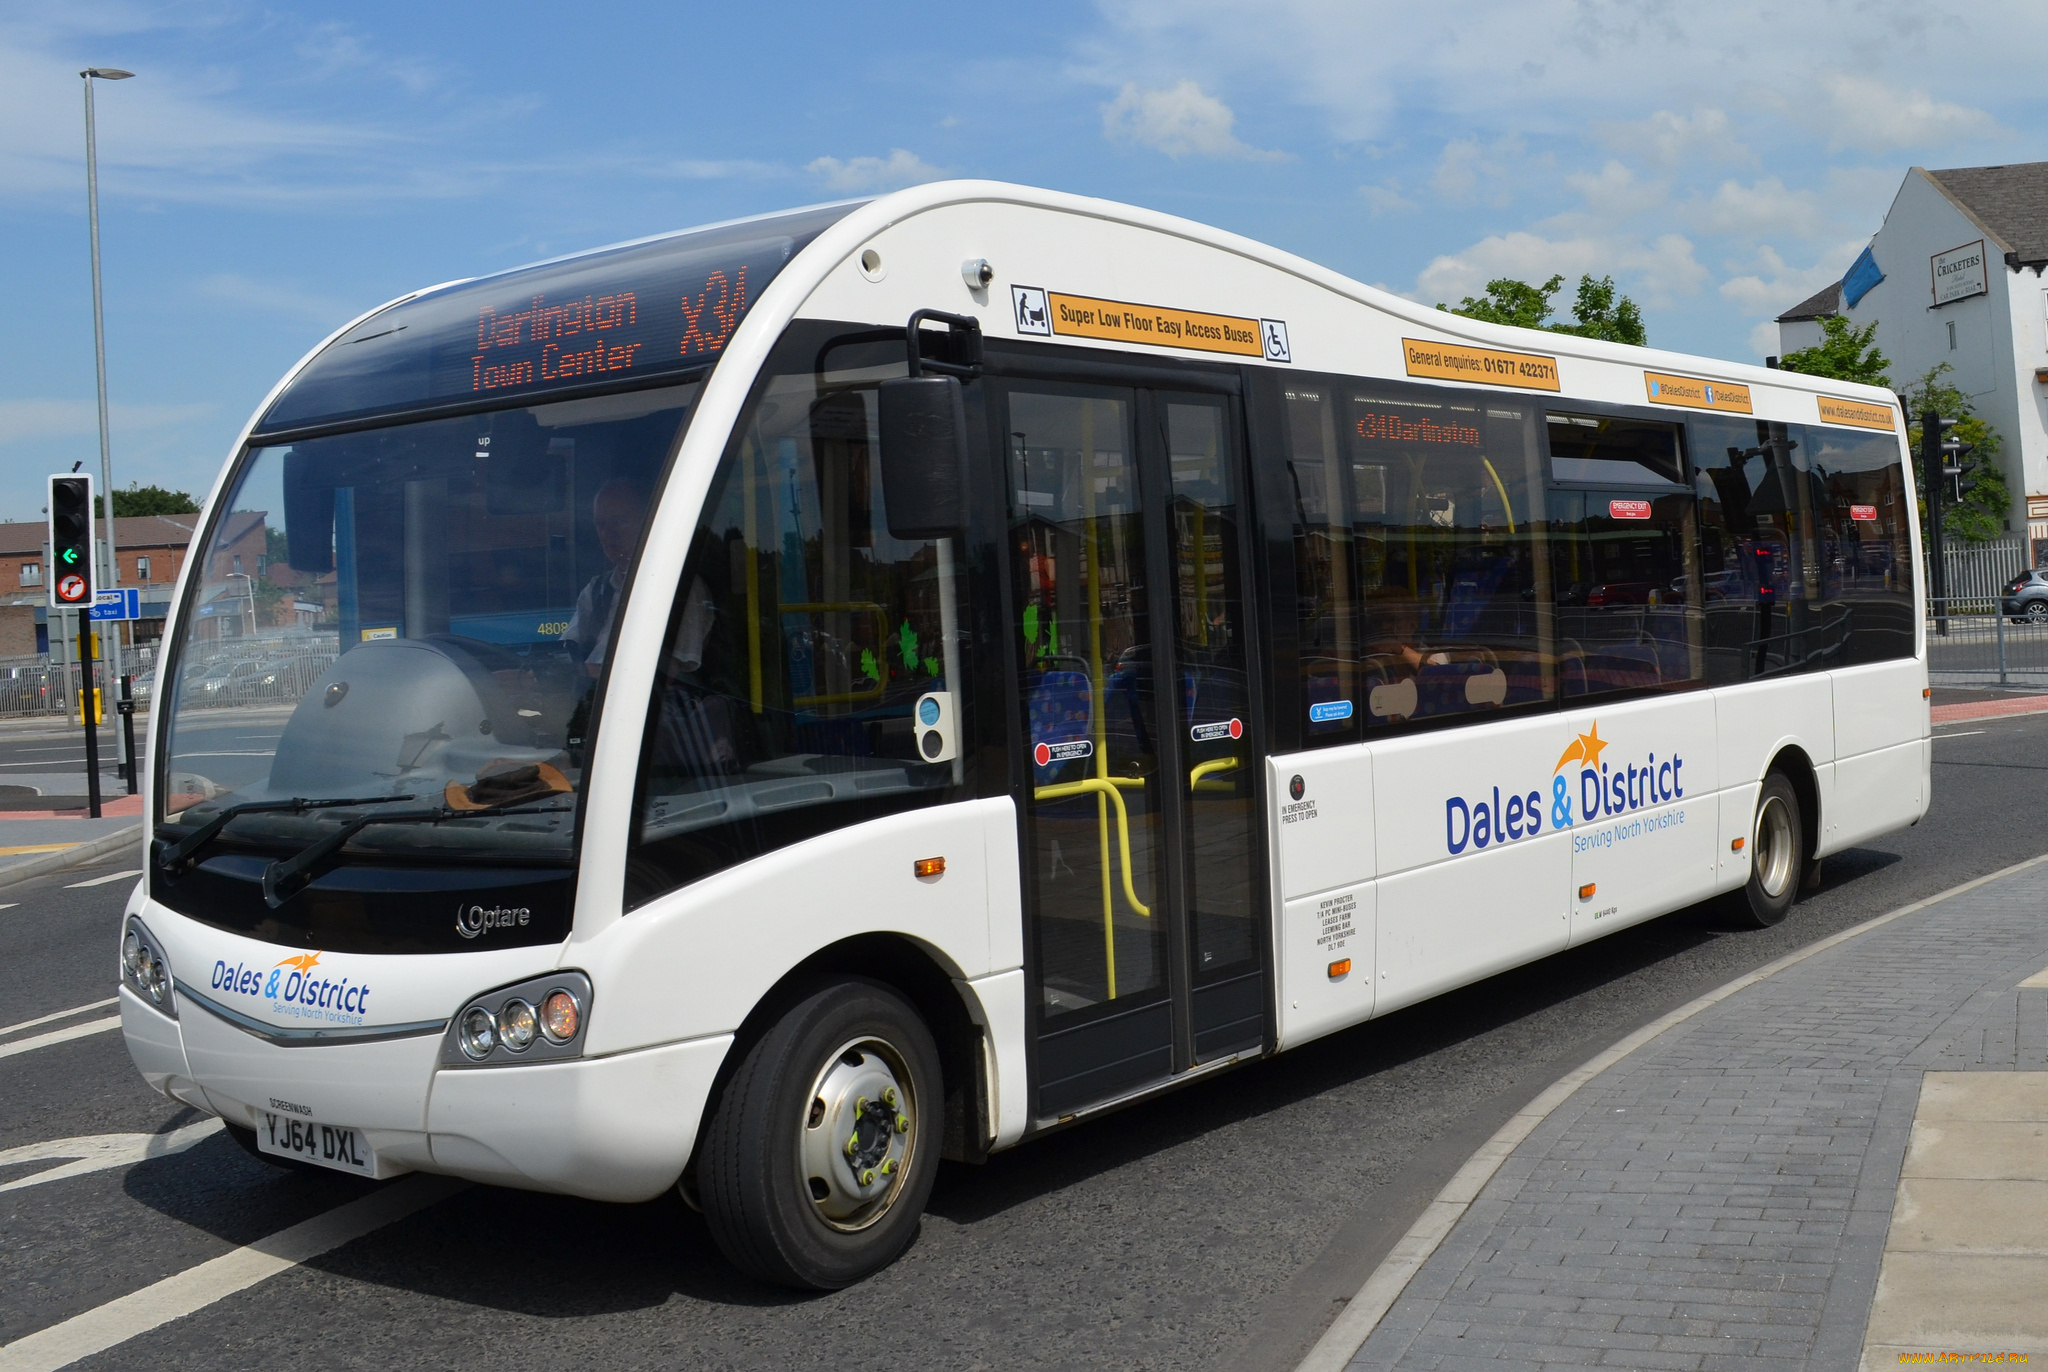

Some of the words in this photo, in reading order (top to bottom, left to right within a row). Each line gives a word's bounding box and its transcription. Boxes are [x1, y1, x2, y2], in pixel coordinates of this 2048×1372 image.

[1937, 254, 1980, 277] CRICKETERS
[477, 291, 637, 350] Darlington
[1060, 303, 1094, 327] Super
[1098, 309, 1121, 328] Low
[1124, 312, 1153, 331] Floor
[1156, 317, 1182, 338] Easy
[1185, 320, 1221, 340] Access
[1224, 324, 1254, 344] Buses
[471, 355, 533, 391] Town
[541, 339, 642, 380] Center
[1409, 347, 1441, 367] General
[1444, 355, 1482, 372] enquiries:
[1484, 357, 1515, 375] 01677
[1519, 362, 1555, 380] 422371
[478, 436, 491, 447] up
[1612, 502, 1637, 510] EMERGENCY
[1638, 502, 1647, 510] EXIT
[537, 621, 569, 635] 4808
[1062, 749, 1083, 757] EMERGENCY
[1281, 805, 1287, 815] IN
[1287, 799, 1316, 813] EMERGENCY
[1445, 785, 1542, 855] Dales
[1551, 775, 1573, 830] &
[1580, 752, 1683, 822] District
[1282, 813, 1298, 825] PRESS
[1298, 811, 1304, 821] TO
[1305, 809, 1318, 820] OPEN
[1574, 828, 1612, 853] Serving
[1614, 821, 1641, 843] North
[1643, 809, 1685, 834] Yorkshire
[1320, 900, 1333, 909] KEVIN
[1333, 894, 1353, 906] PROCTER
[1325, 908, 1331, 917] PC
[1331, 902, 1357, 914] MINI-BUSES
[468, 905, 530, 935] Optare
[1322, 916, 1338, 927] LEASES
[1339, 912, 1351, 921] FARM
[1322, 924, 1342, 935] LEEMING
[1342, 921, 1351, 930] BAR
[1316, 936, 1332, 946] NORTH
[1332, 928, 1356, 941] YORKSHIRE
[1327, 942, 1337, 951] DL7
[211, 960, 263, 995] Dales
[264, 968, 281, 999] &
[284, 971, 370, 1014] District
[273, 1001, 300, 1018] Serving
[301, 1006, 323, 1020] North
[324, 1011, 363, 1026] Yorkshire
[269, 1097, 313, 1117] SCREENWASH
[266, 1112, 317, 1155] YJ64
[321, 1125, 364, 1166] DXL
